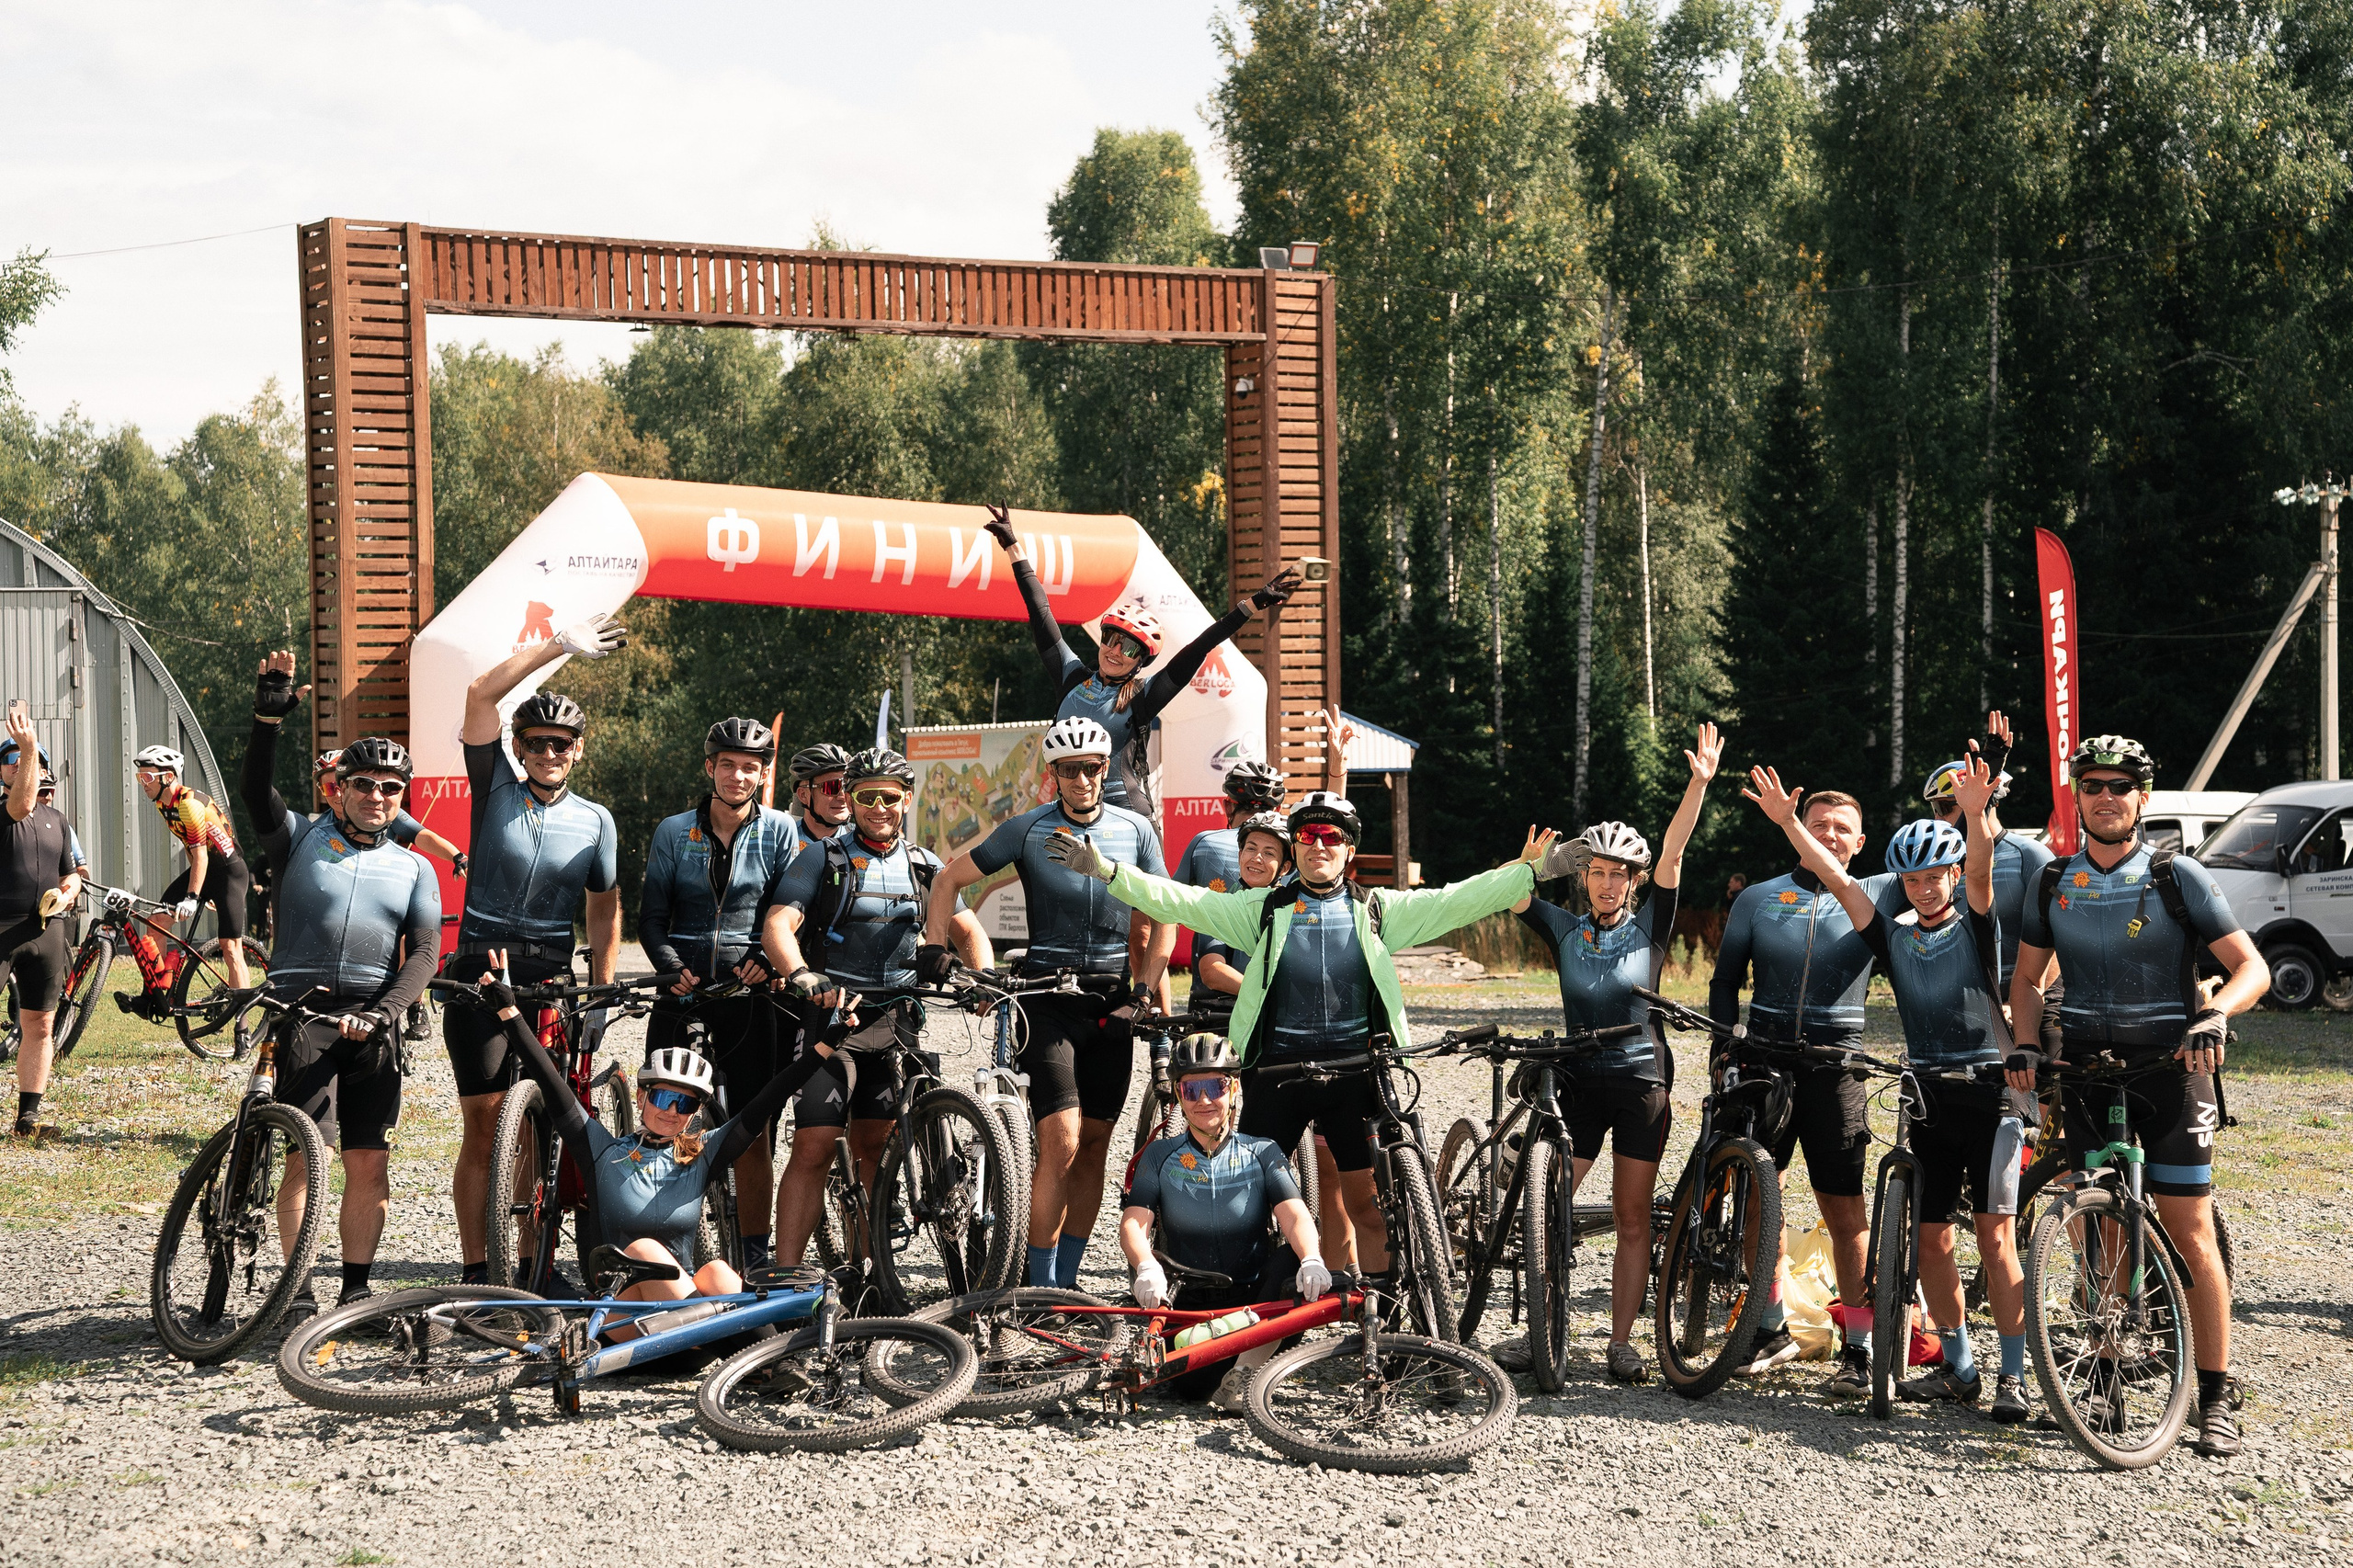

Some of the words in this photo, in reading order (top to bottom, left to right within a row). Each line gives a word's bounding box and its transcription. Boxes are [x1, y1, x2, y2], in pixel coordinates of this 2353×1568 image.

[707, 507, 1074, 596] ФИНИШ
[205, 820, 235, 858] SIBERIA
[1458, 1351, 1492, 1373] BARZO
